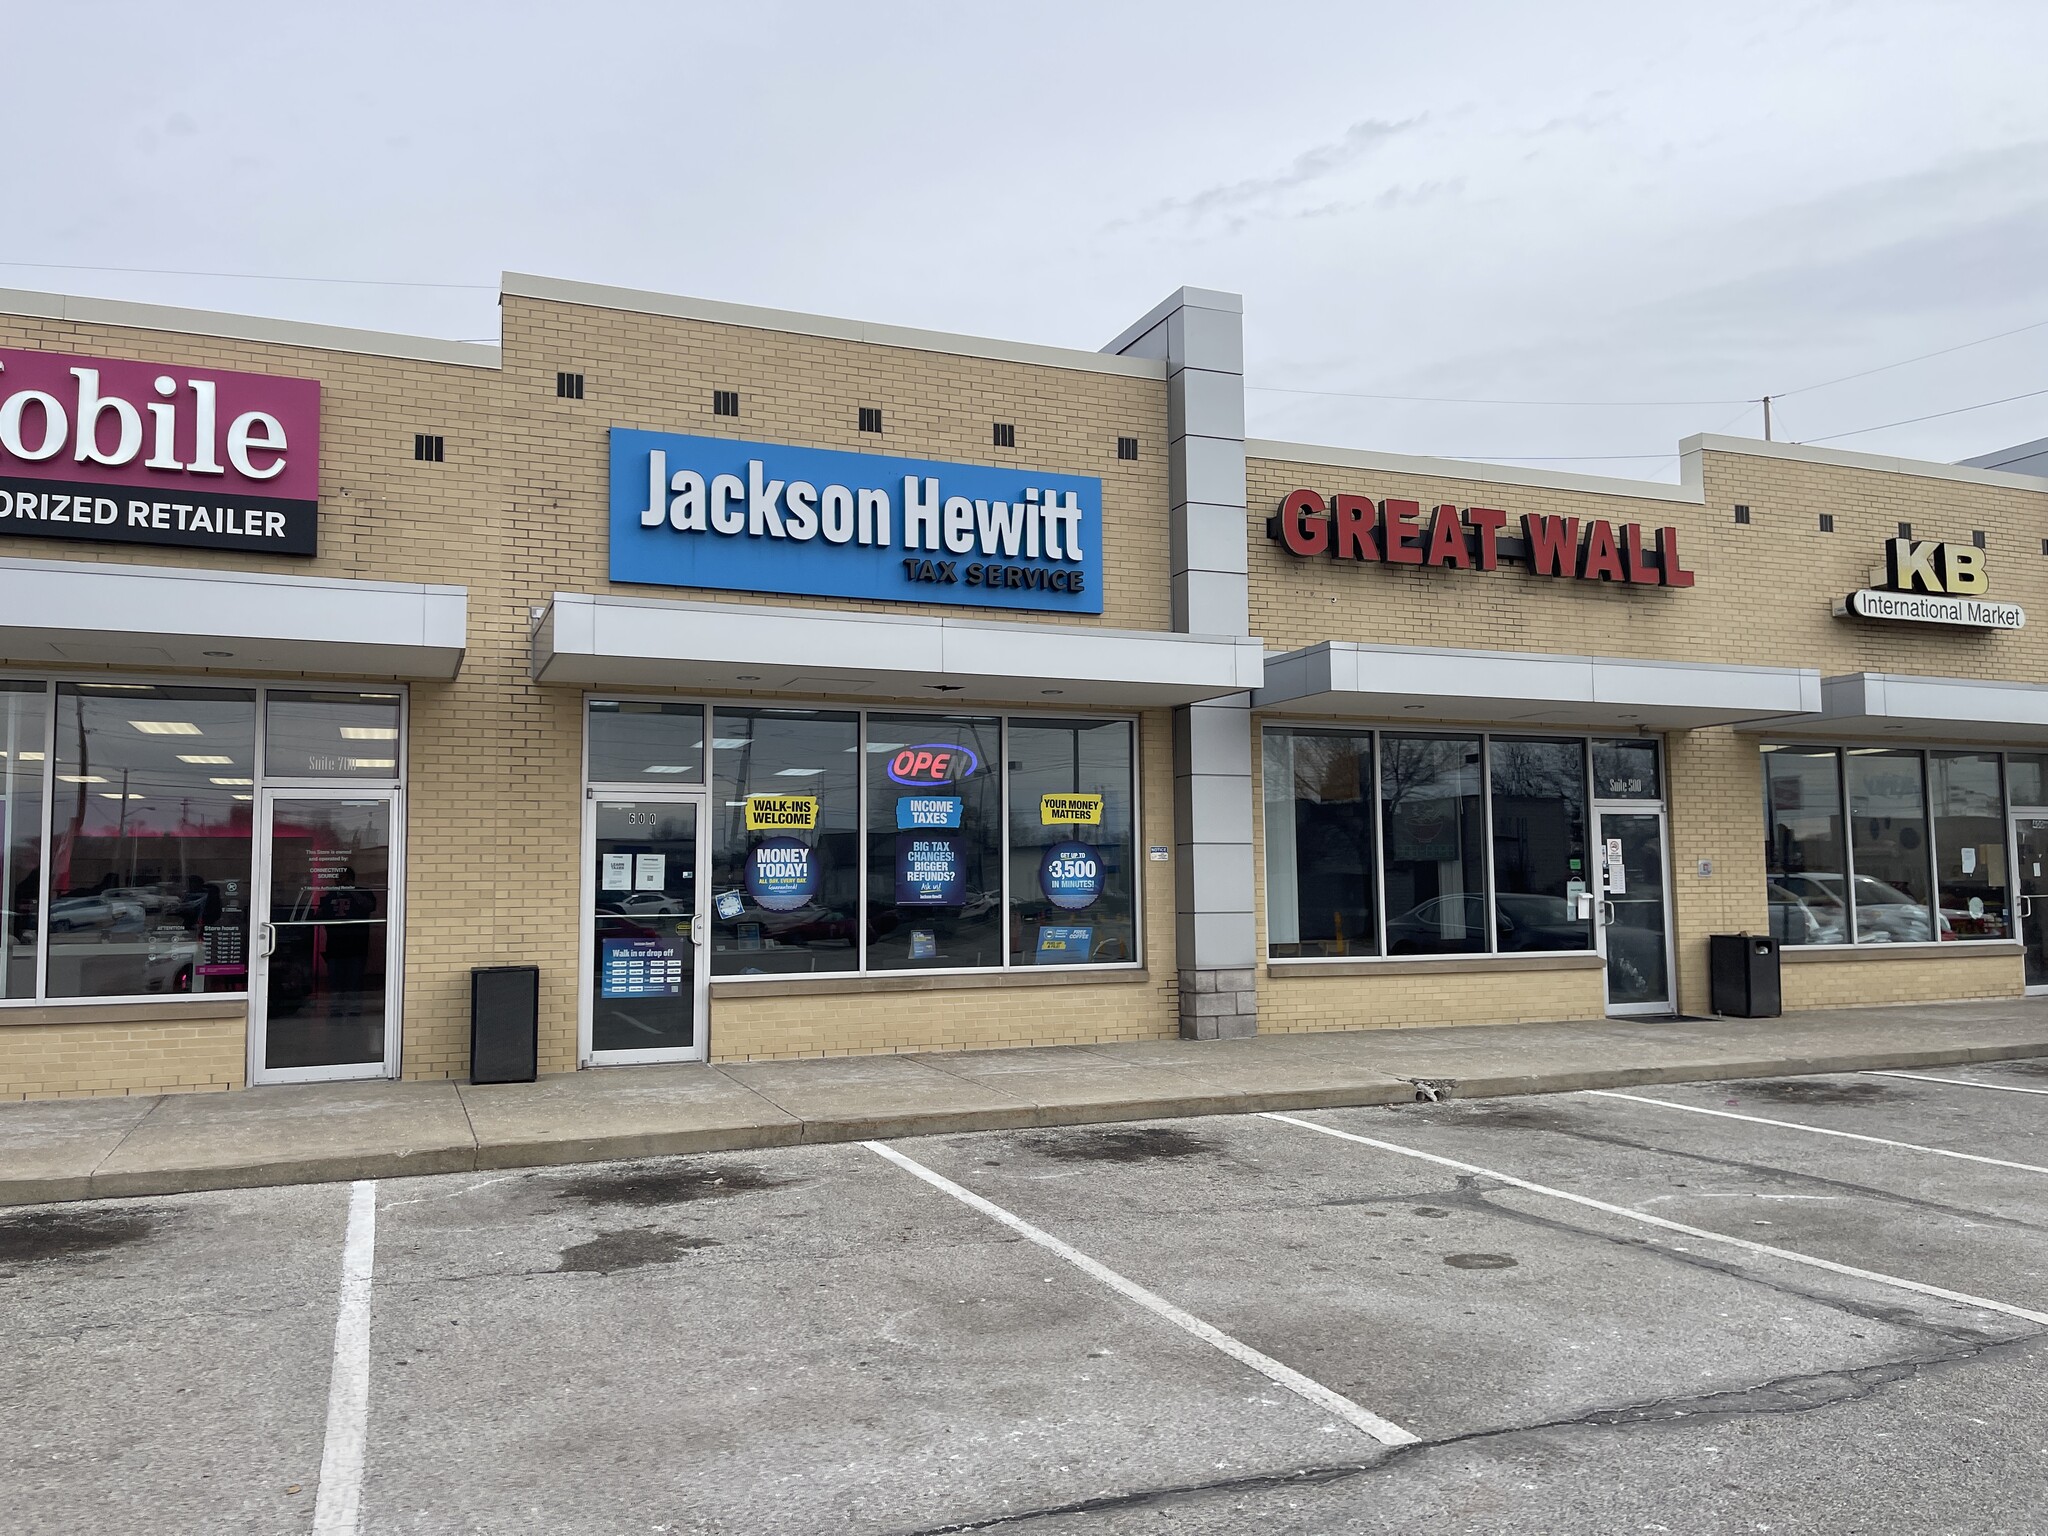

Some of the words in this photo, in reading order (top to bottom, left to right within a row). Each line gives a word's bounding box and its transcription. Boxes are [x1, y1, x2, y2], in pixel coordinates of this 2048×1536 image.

[0, 361, 287, 479] obile
[641, 449, 891, 546] Jackson
[903, 475, 1083, 561] Hewitt
[128, 501, 286, 538] RETAILER
[1279, 489, 1506, 571] GREAT
[1520, 513, 1695, 588] WALL
[1888, 538, 1989, 595] KB
[903, 559, 958, 583] TAX
[966, 563, 1085, 592] SERVICE
[1863, 593, 1962, 621] International
[1967, 603, 2020, 626] Market
[309, 756, 335, 771] Suite
[893, 751, 968, 780] OPEN
[1610, 779, 1627, 792] Suite
[1628, 779, 1642, 792] 500
[754, 800, 811, 812] WALK-INS
[910, 800, 953, 813] INCOME
[1044, 799, 1067, 809] YOUR
[1069, 800, 1099, 810] MONEY
[629, 813, 656, 825] 600
[753, 812, 811, 824] WELCOME
[912, 812, 947, 824] TAXES
[1052, 809, 1091, 819] MATTERS
[913, 842, 929, 851] BIG
[931, 842, 950, 851] TAX
[757, 848, 809, 863] MONEY
[908, 852, 954, 861] CHANGES!
[757, 863, 808, 877] TODAY!
[914, 862, 948, 871] BIGGER
[1049, 860, 1096, 879] $3,500
[907, 871, 955, 882] REFUNDS?
[1052, 880, 1059, 888] IN
[1061, 880, 1094, 888] MINUTES!
[612, 949, 630, 957] Walk
[631, 949, 637, 957] in
[646, 949, 662, 958] drop
[663, 949, 674, 957] off
